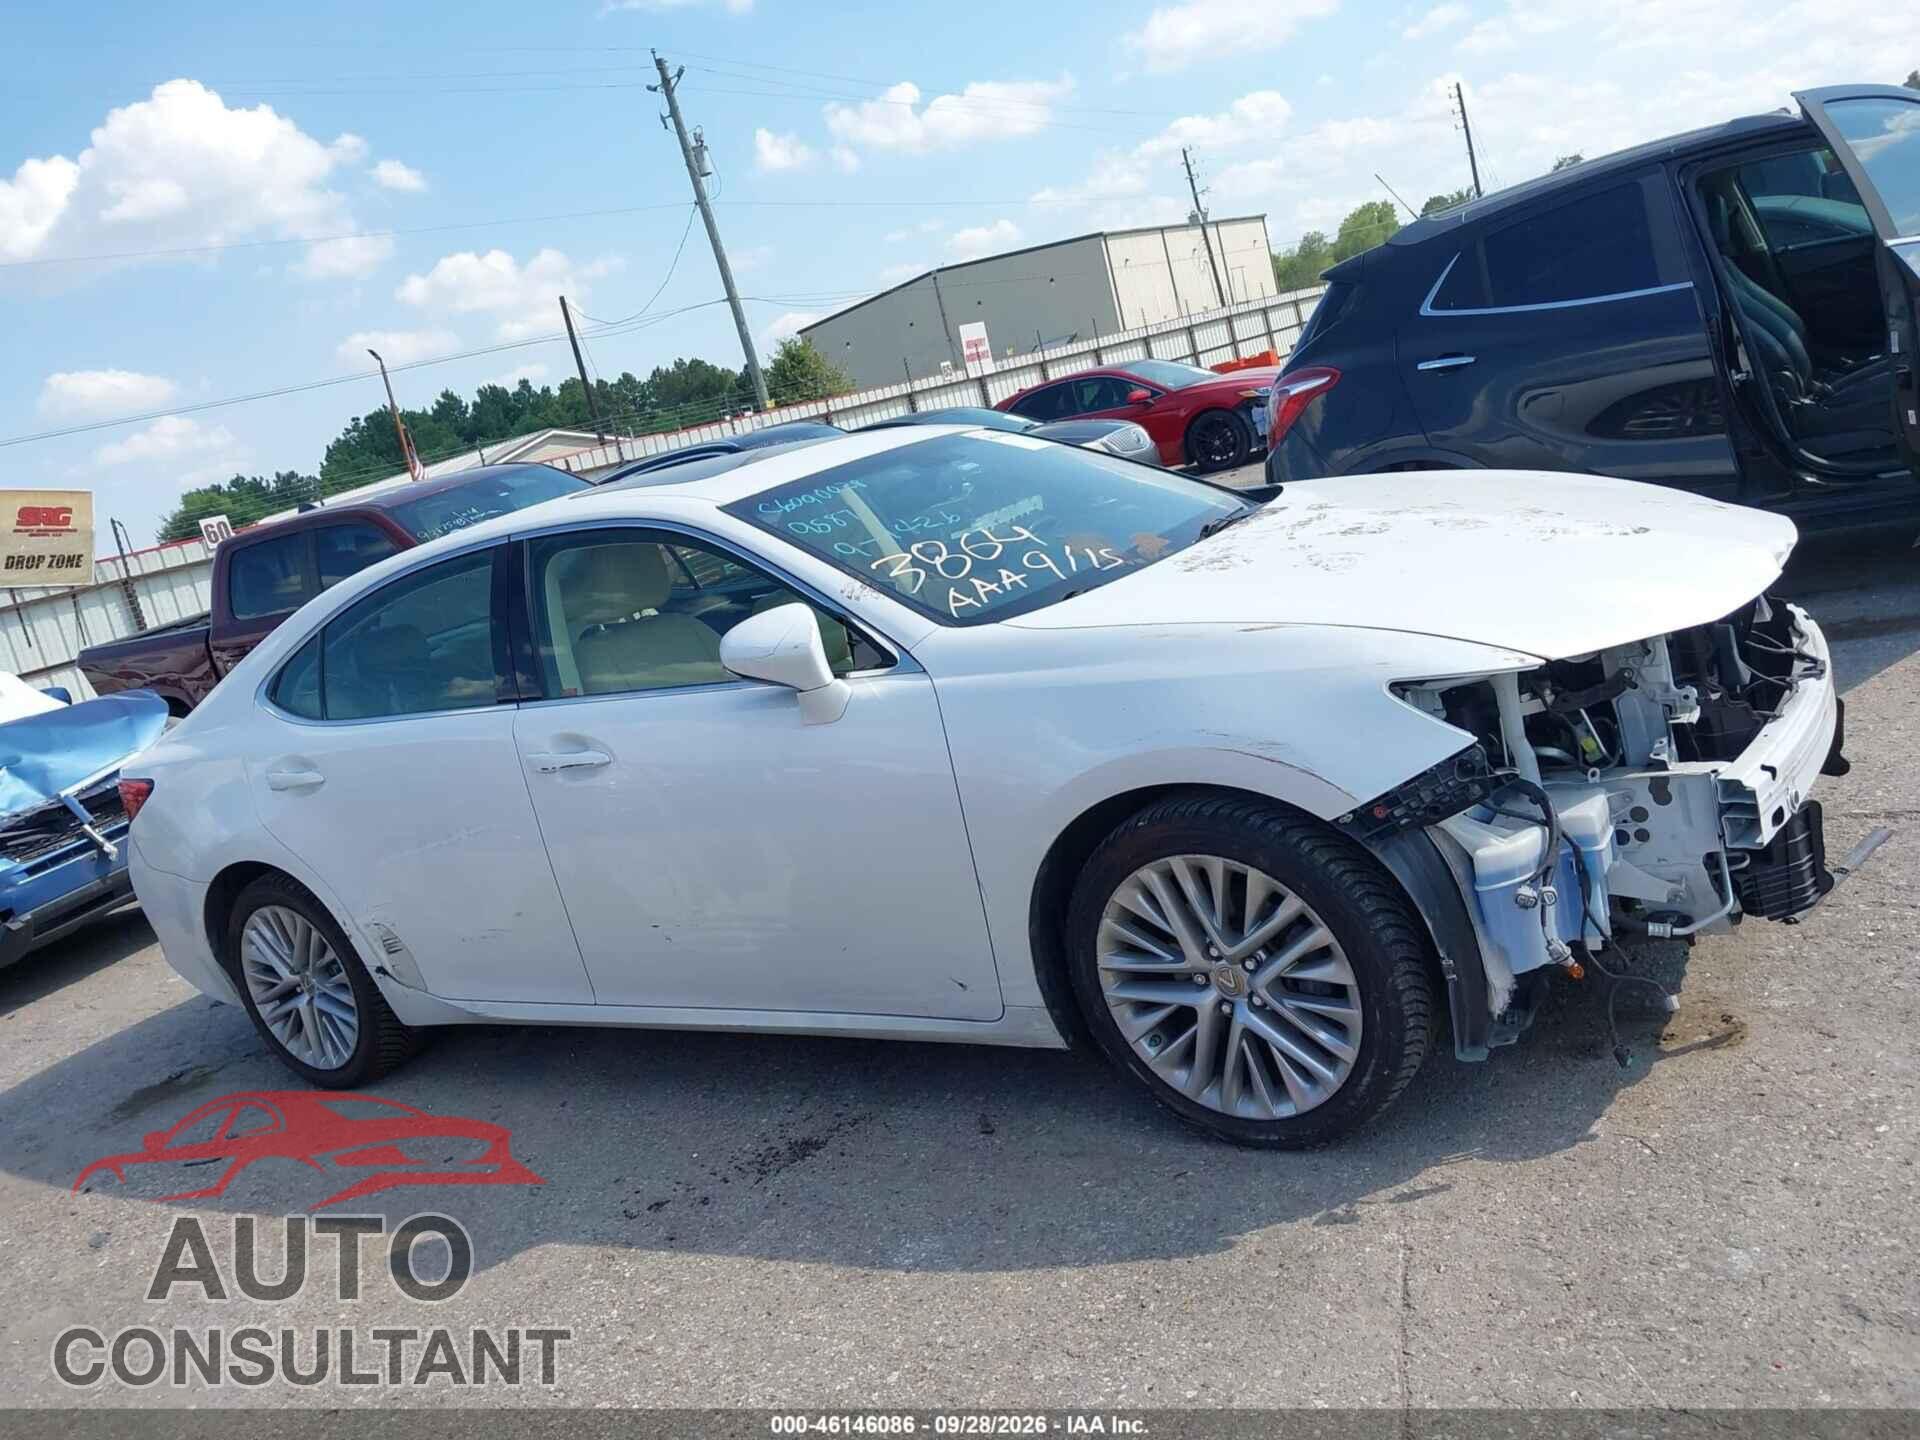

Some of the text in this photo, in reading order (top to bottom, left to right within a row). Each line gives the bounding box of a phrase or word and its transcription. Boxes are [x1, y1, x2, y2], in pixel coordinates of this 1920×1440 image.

[203, 521, 231, 544] 60
[4, 553, 84, 570] DROP ZONE
[948, 568, 1029, 618] AAA
